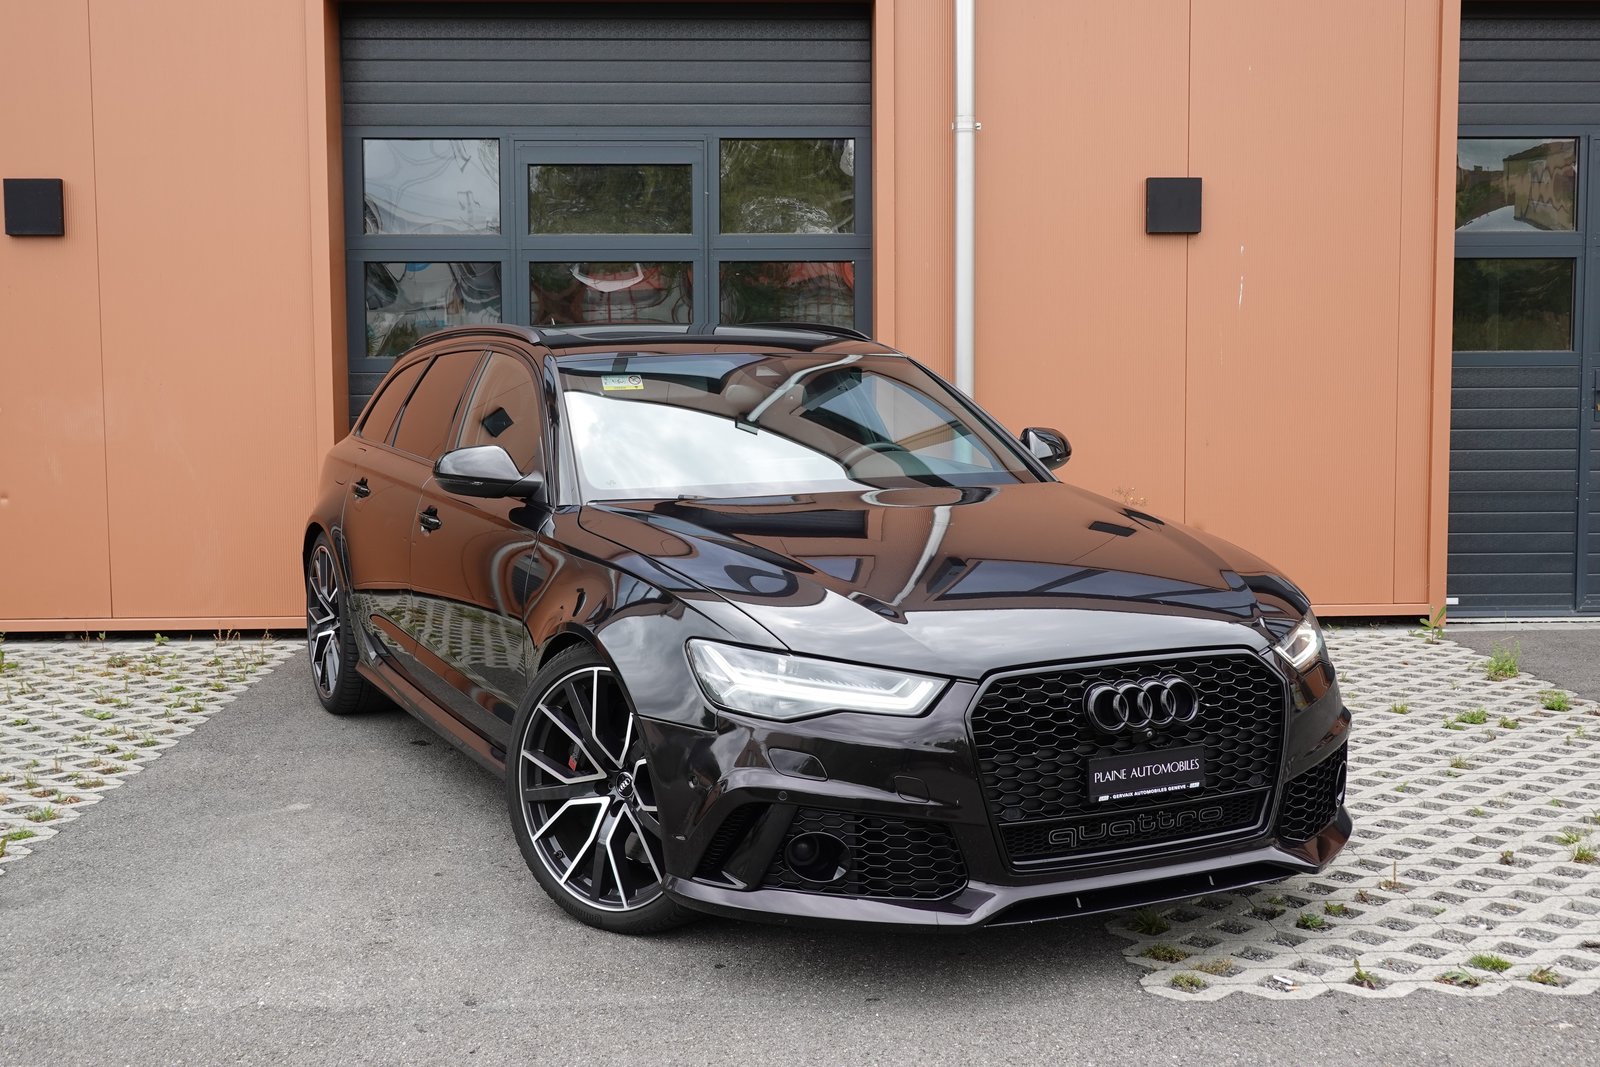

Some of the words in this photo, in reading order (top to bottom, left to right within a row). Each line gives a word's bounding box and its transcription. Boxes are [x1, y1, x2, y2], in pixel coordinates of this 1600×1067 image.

[1094, 768, 1127, 783] PLAINE
[1130, 758, 1200, 779] AUTOMOBILES
[1112, 792, 1134, 800] GERVAIX
[1134, 787, 1167, 796] AUTOMOBILES
[1048, 805, 1223, 847] quattro
